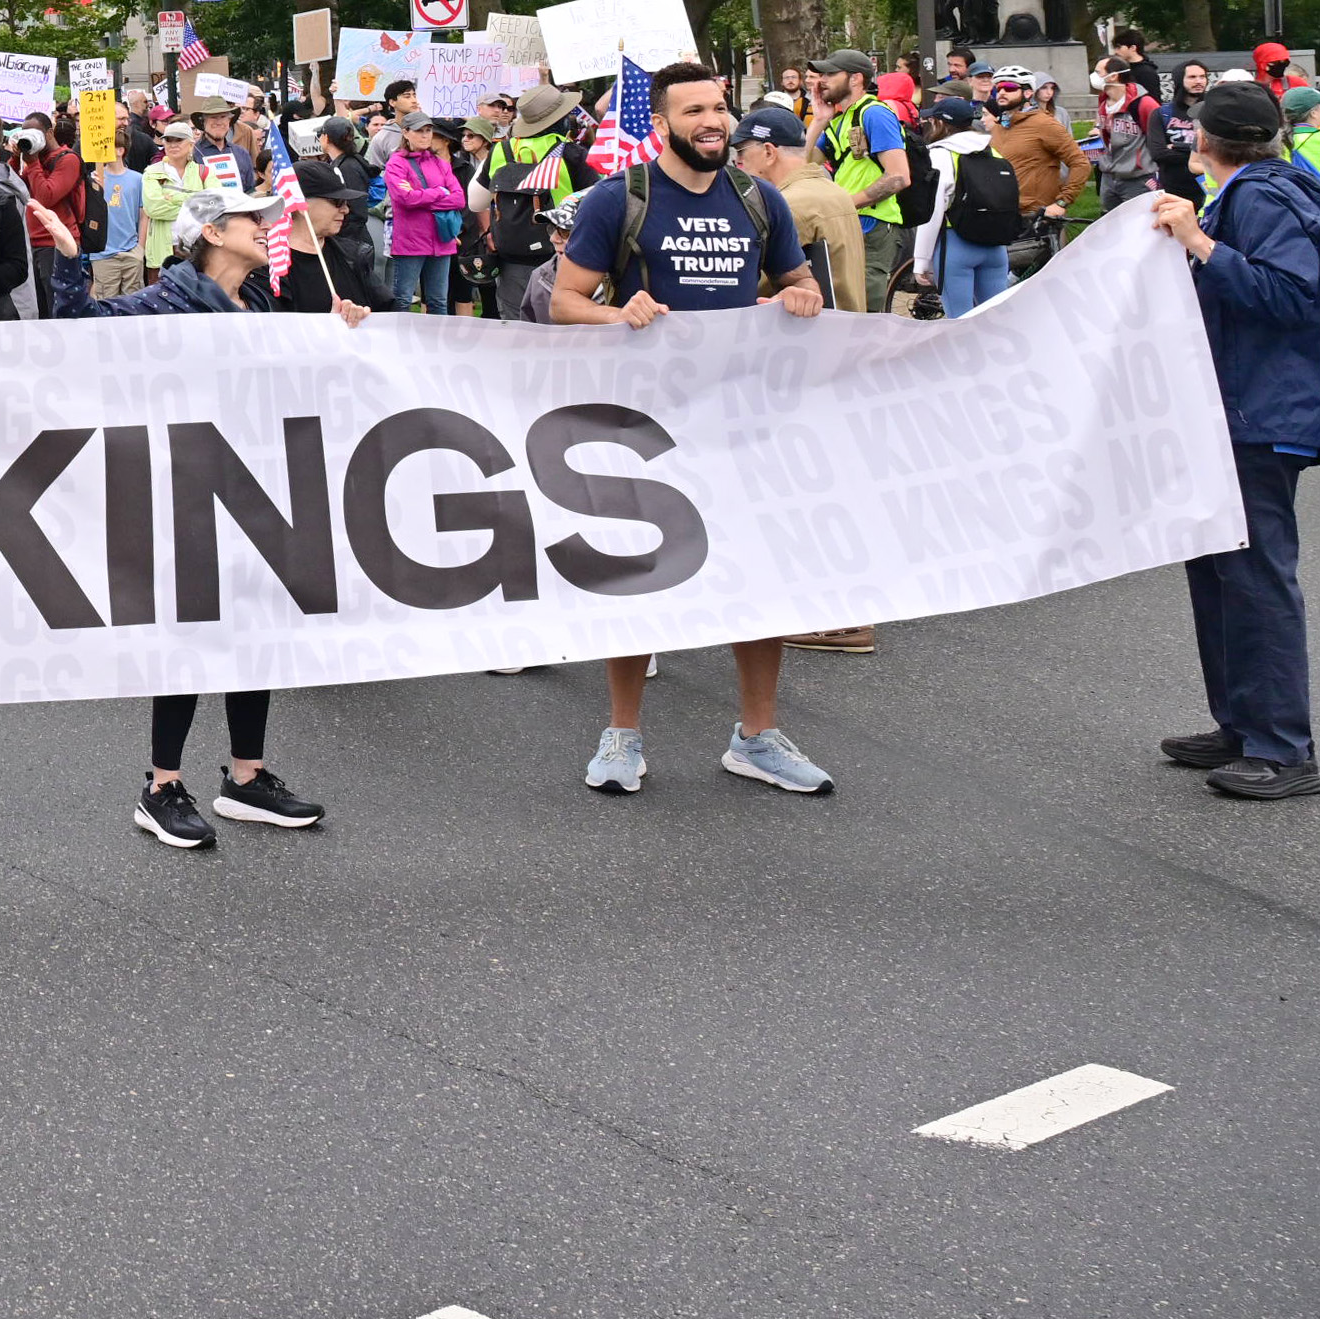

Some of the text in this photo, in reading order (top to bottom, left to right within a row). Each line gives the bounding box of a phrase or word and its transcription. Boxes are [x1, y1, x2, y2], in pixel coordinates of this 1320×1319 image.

[166, 13, 176, 21] NO
[490, 16, 520, 33] KEEP
[521, 37, 539, 51] OF
[405, 48, 423, 63] LOL
[429, 47, 502, 64] TRUMP HAS
[70, 61, 104, 71] THE ONLY
[425, 64, 502, 82] A MUGSHOT
[79, 71, 92, 79] ICE
[433, 84, 487, 102] MY DAD
[433, 100, 478, 117] DOESN
[677, 217, 731, 232] VETS
[661, 236, 750, 252] AGAINST
[671, 256, 745, 272] TRUMP
[728, 339, 1172, 503] NO KINGS NO
[759, 429, 1195, 585] NO KINGS NO
